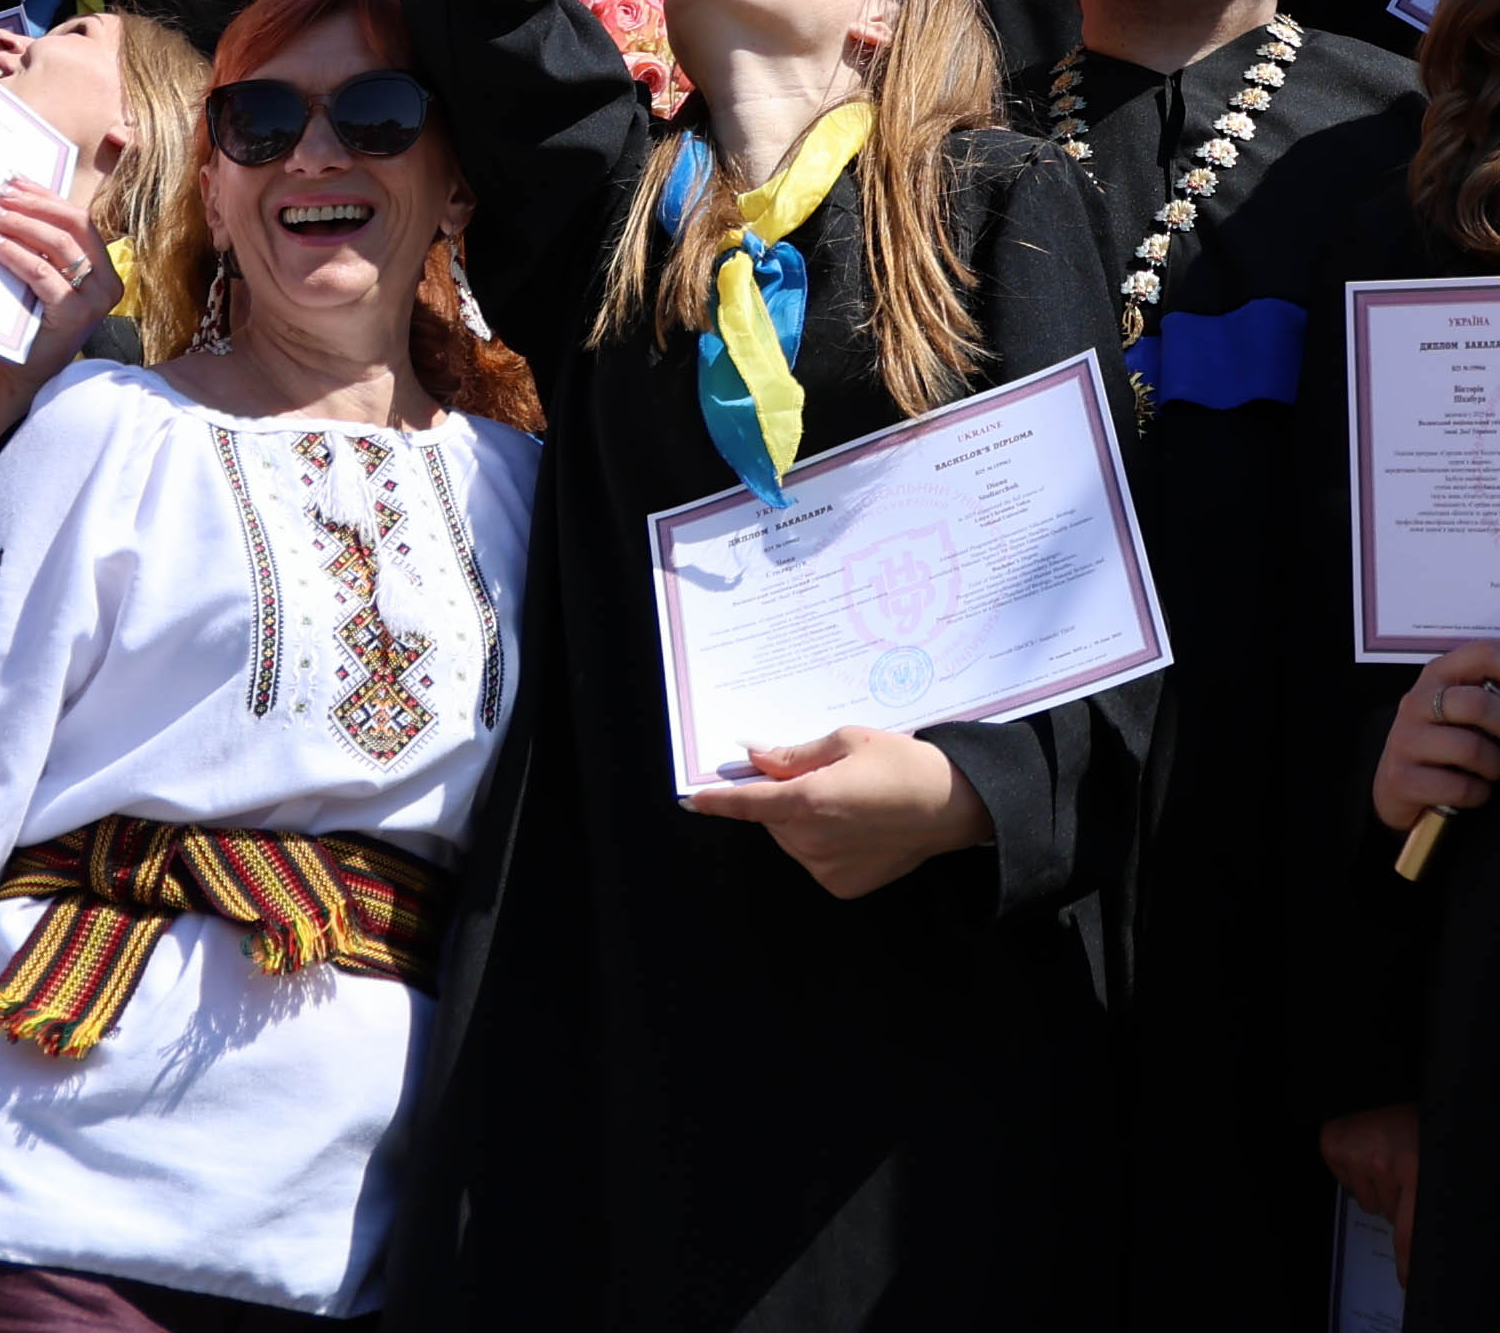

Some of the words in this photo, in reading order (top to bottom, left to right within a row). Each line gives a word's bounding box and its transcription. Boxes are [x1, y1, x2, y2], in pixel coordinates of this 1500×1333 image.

[1448, 316, 1491, 327] УКРАЇНА
[1419, 342, 1458, 351] ДИПЛОМ
[957, 421, 1005, 443] UKRAINE
[934, 446, 990, 472] BACHELOR'S
[993, 430, 1034, 450] DIPLOMA
[728, 528, 769, 549] ДИПЛОМ
[775, 504, 834, 532] БАКАЛАВРА
